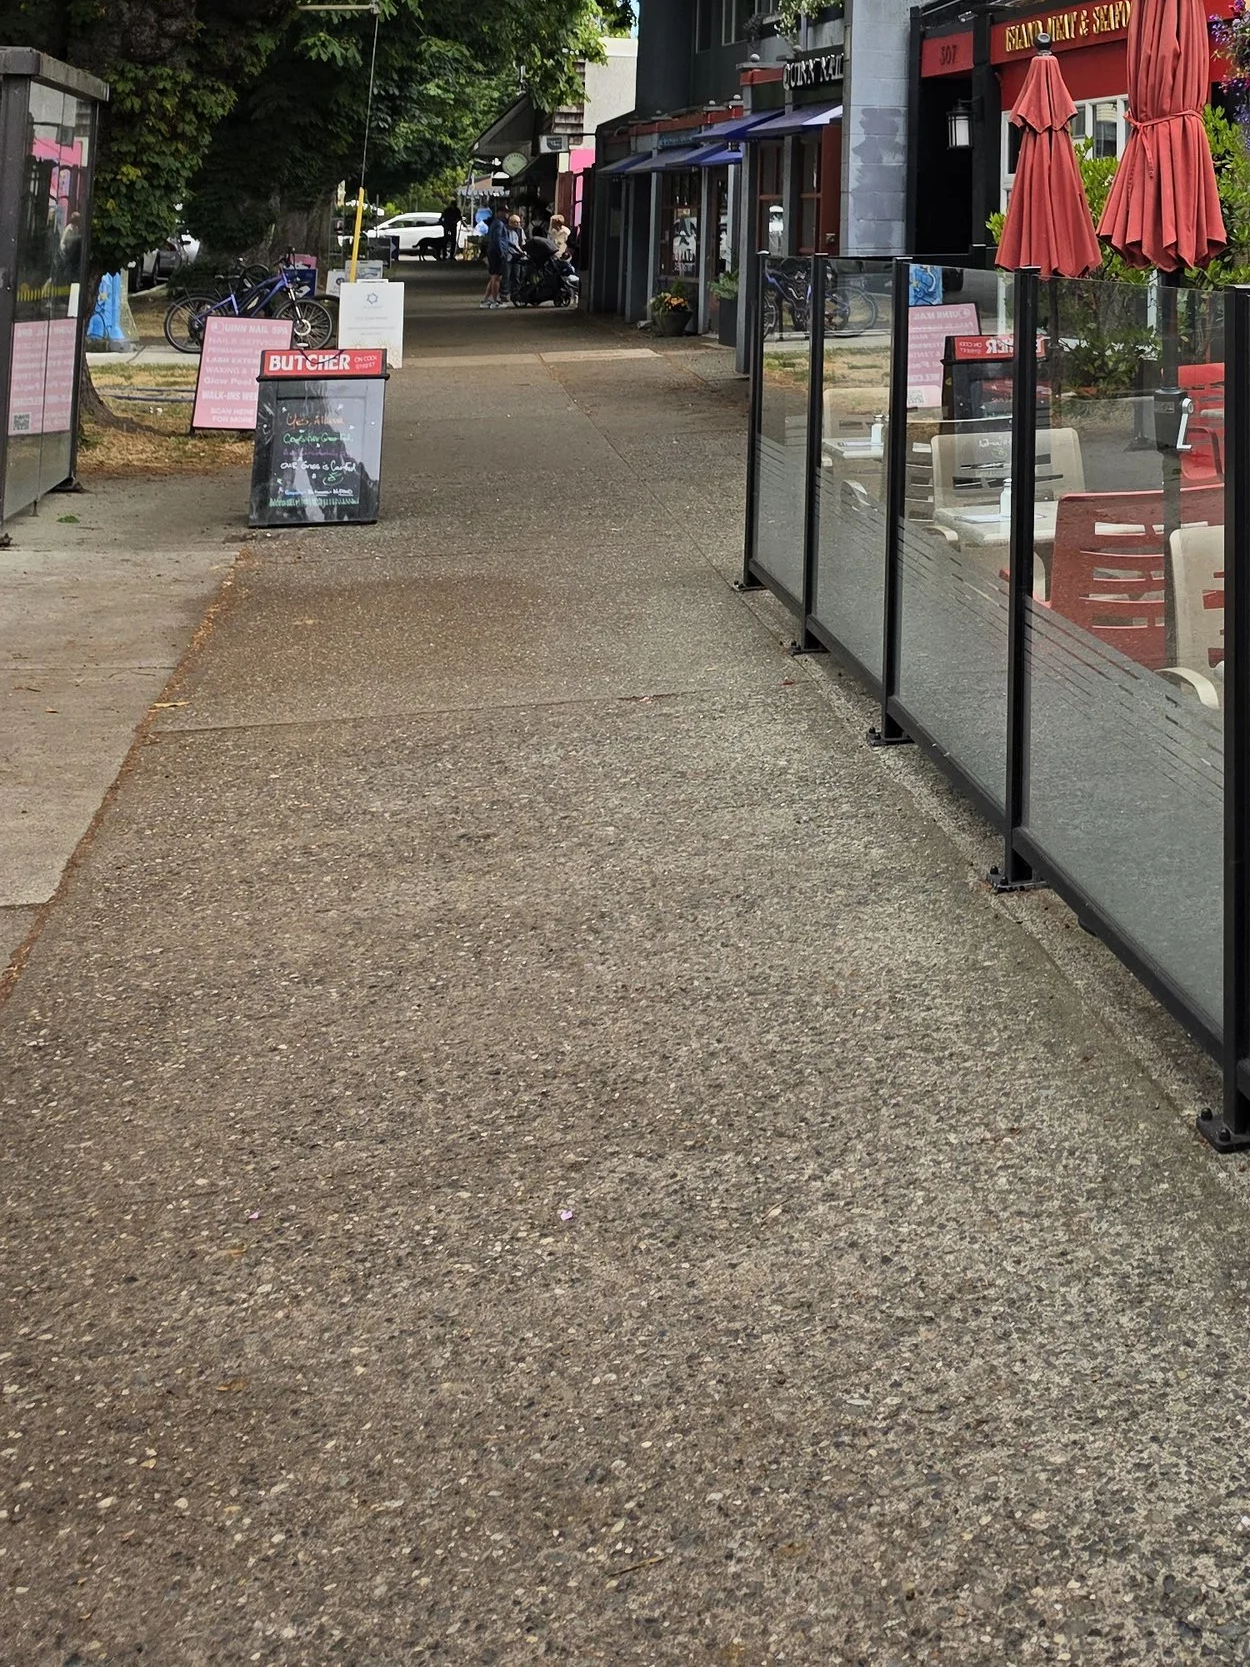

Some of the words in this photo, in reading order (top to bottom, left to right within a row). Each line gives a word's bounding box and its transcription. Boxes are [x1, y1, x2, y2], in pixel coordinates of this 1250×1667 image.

[1047, 11, 1078, 42] MEAT
[1079, 10, 1090, 36] &
[1093, 0, 1131, 34] SEAFO
[249, 326, 269, 334] NAIL
[271, 326, 288, 335] SPA
[269, 355, 351, 372] BUTCHER
[202, 390, 240, 401] WALK-INS
